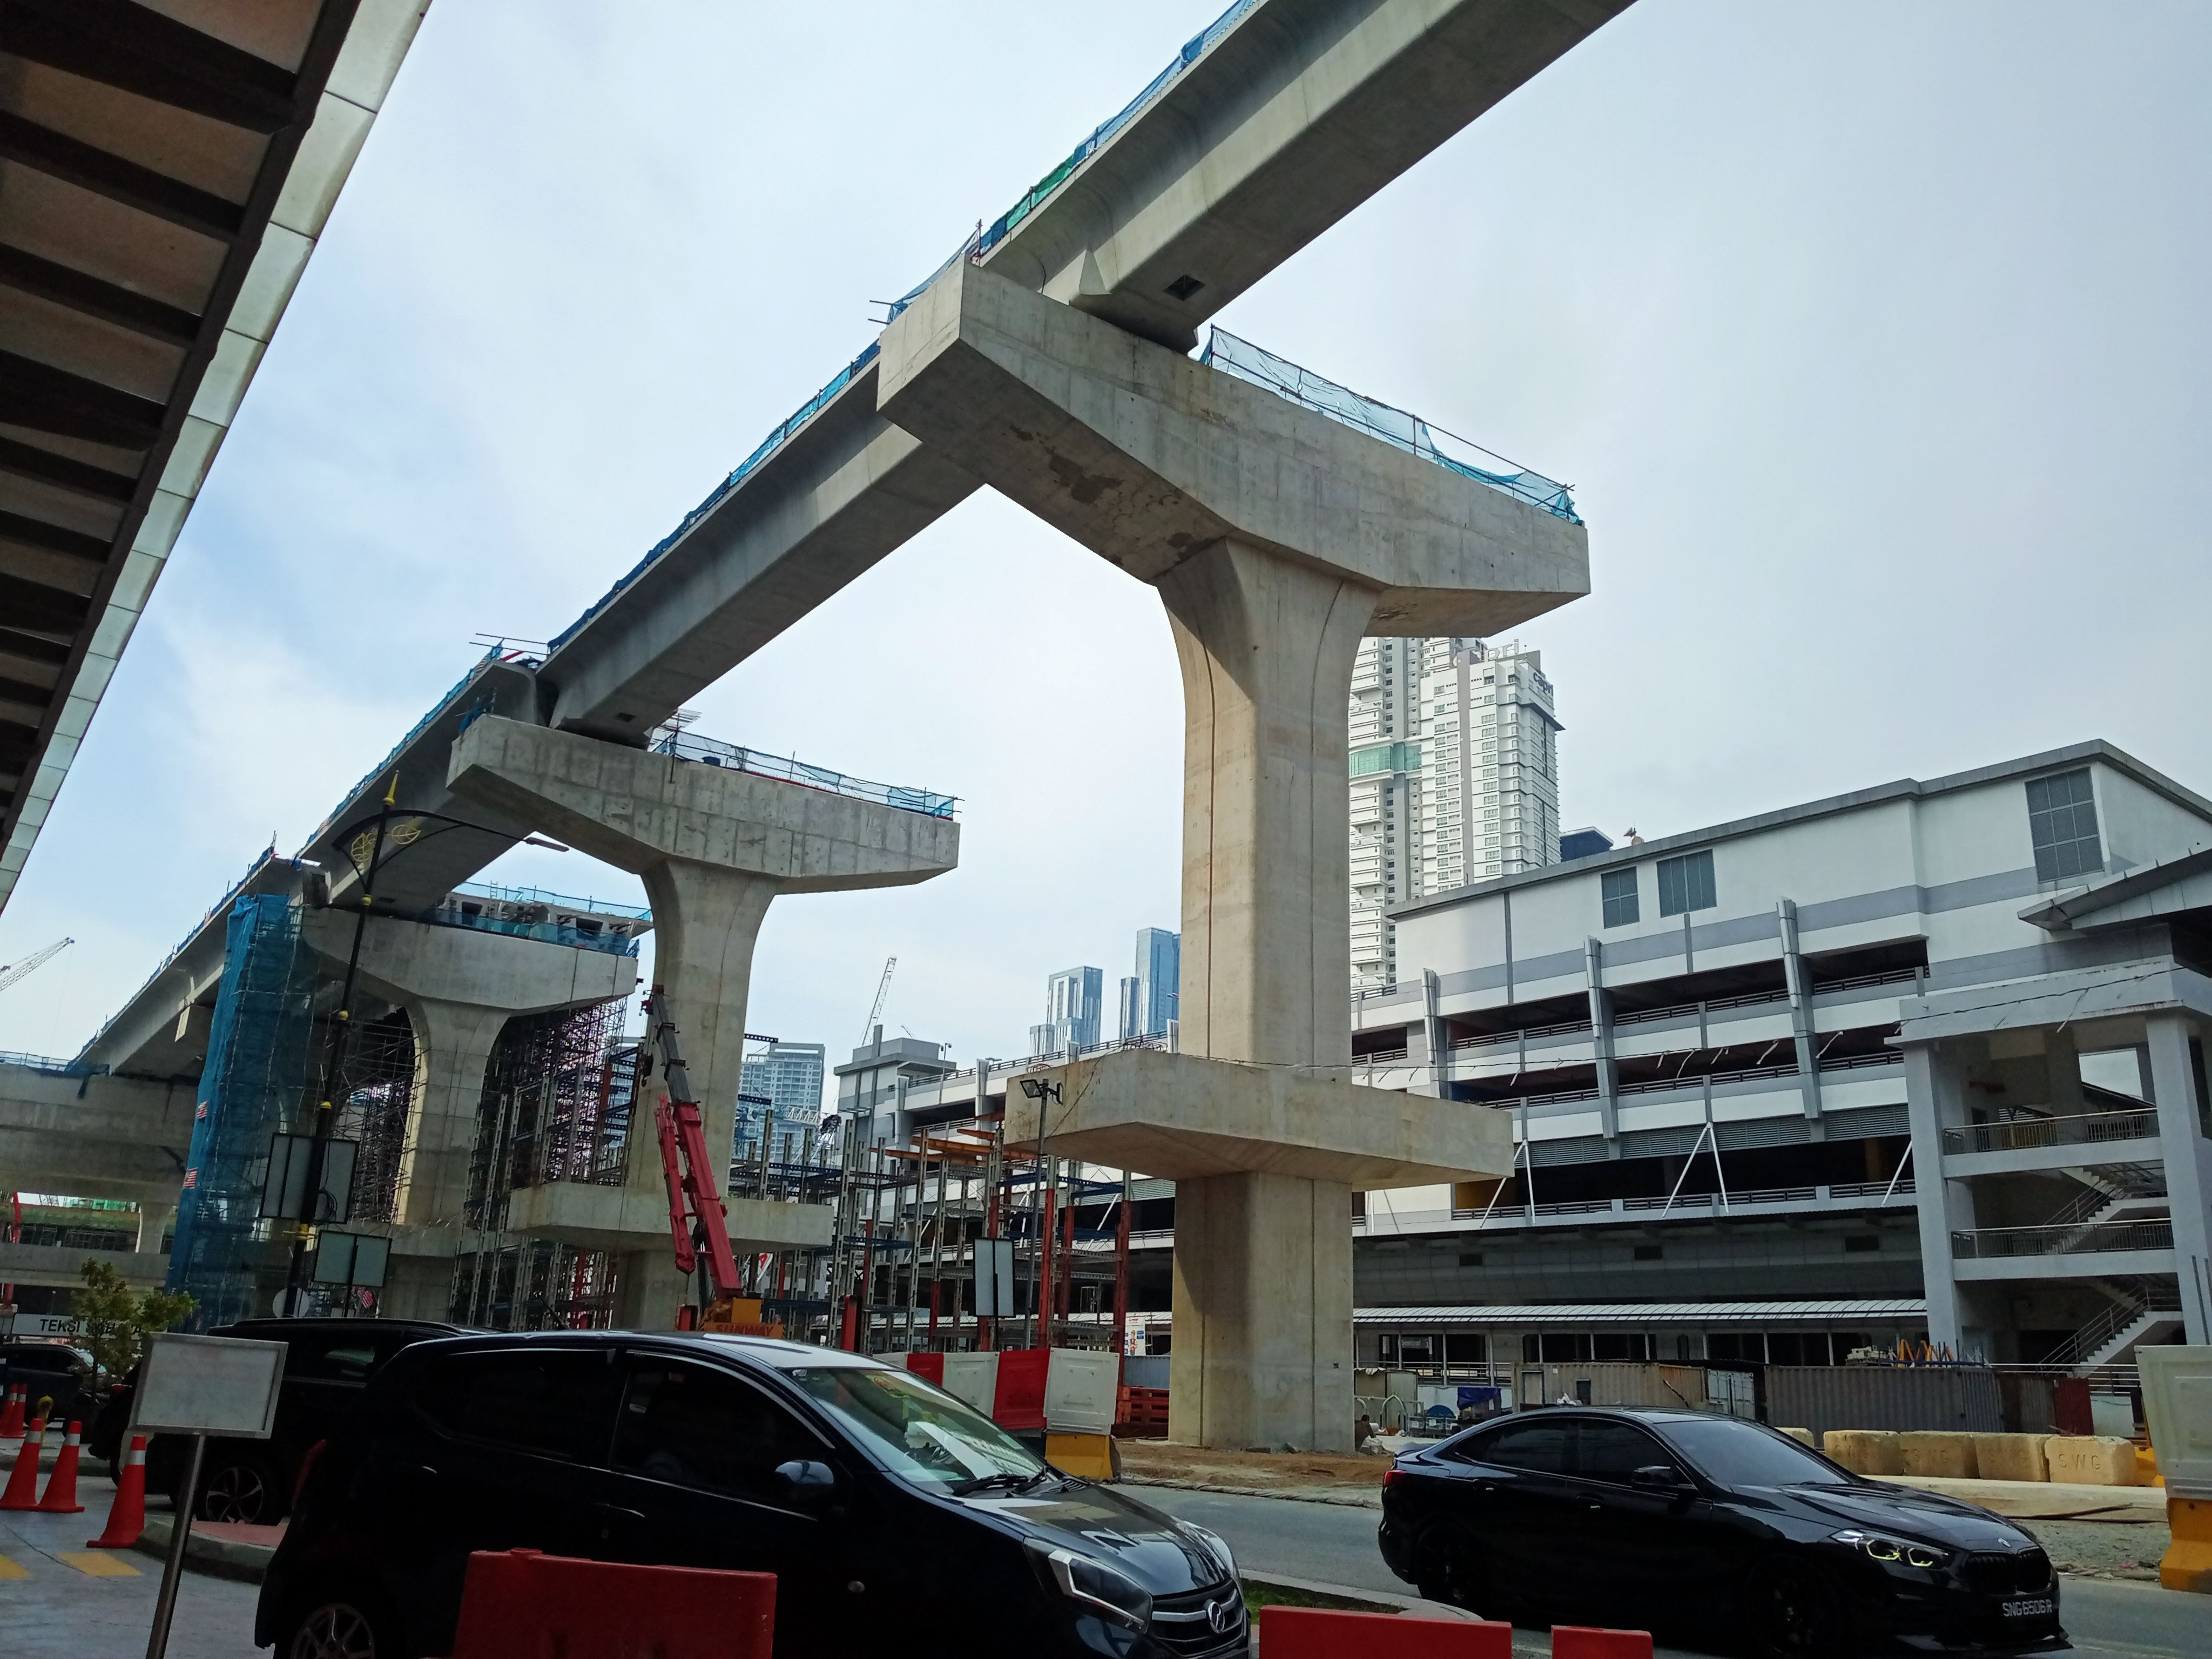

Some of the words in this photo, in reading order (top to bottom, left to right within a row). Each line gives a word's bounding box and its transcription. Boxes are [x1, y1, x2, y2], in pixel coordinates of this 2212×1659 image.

[1533, 672, 1553, 697] capri
[40, 1318, 80, 1333] TEKSI
[716, 1324, 773, 1336] SUNWAY
[2058, 1454, 2100, 1470] SWG
[2002, 1599, 2052, 1616] SNG6506R
